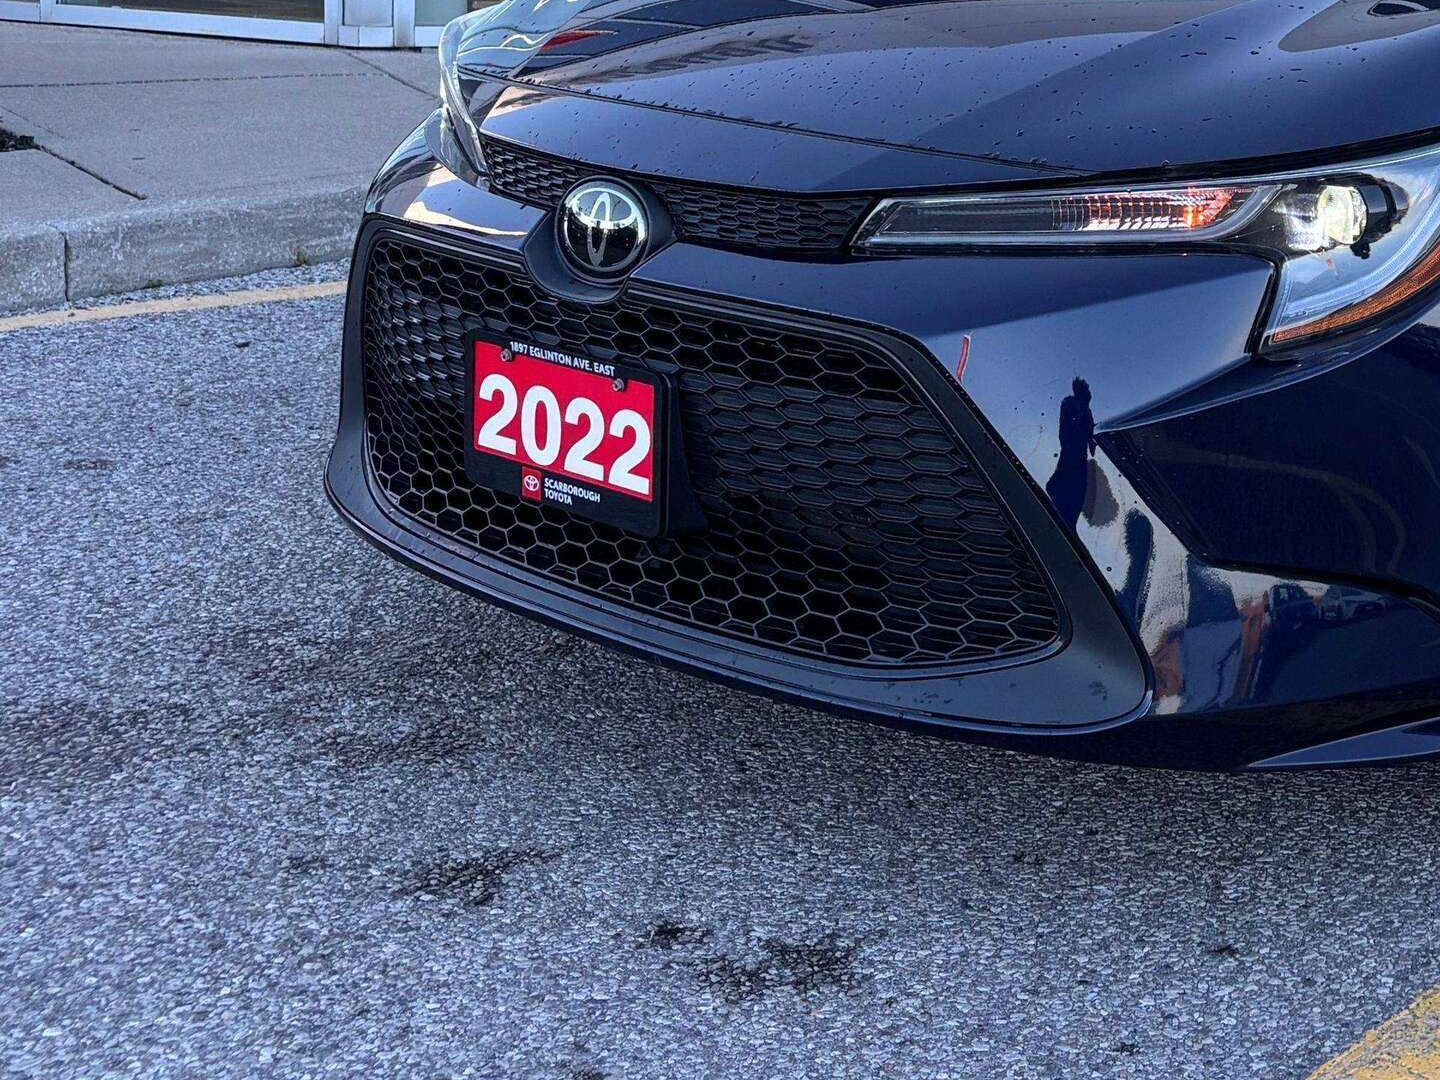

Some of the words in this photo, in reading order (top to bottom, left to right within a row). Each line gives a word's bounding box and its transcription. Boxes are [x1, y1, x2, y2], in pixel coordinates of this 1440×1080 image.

[510, 341, 528, 355] 1897
[529, 345, 573, 367] EGLINTON
[573, 357, 593, 372] AVE.
[593, 362, 616, 377] EAST
[477, 373, 651, 496] 2022
[544, 477, 601, 503] SCARBOROUGH
[544, 488, 573, 506] TOYOTA
